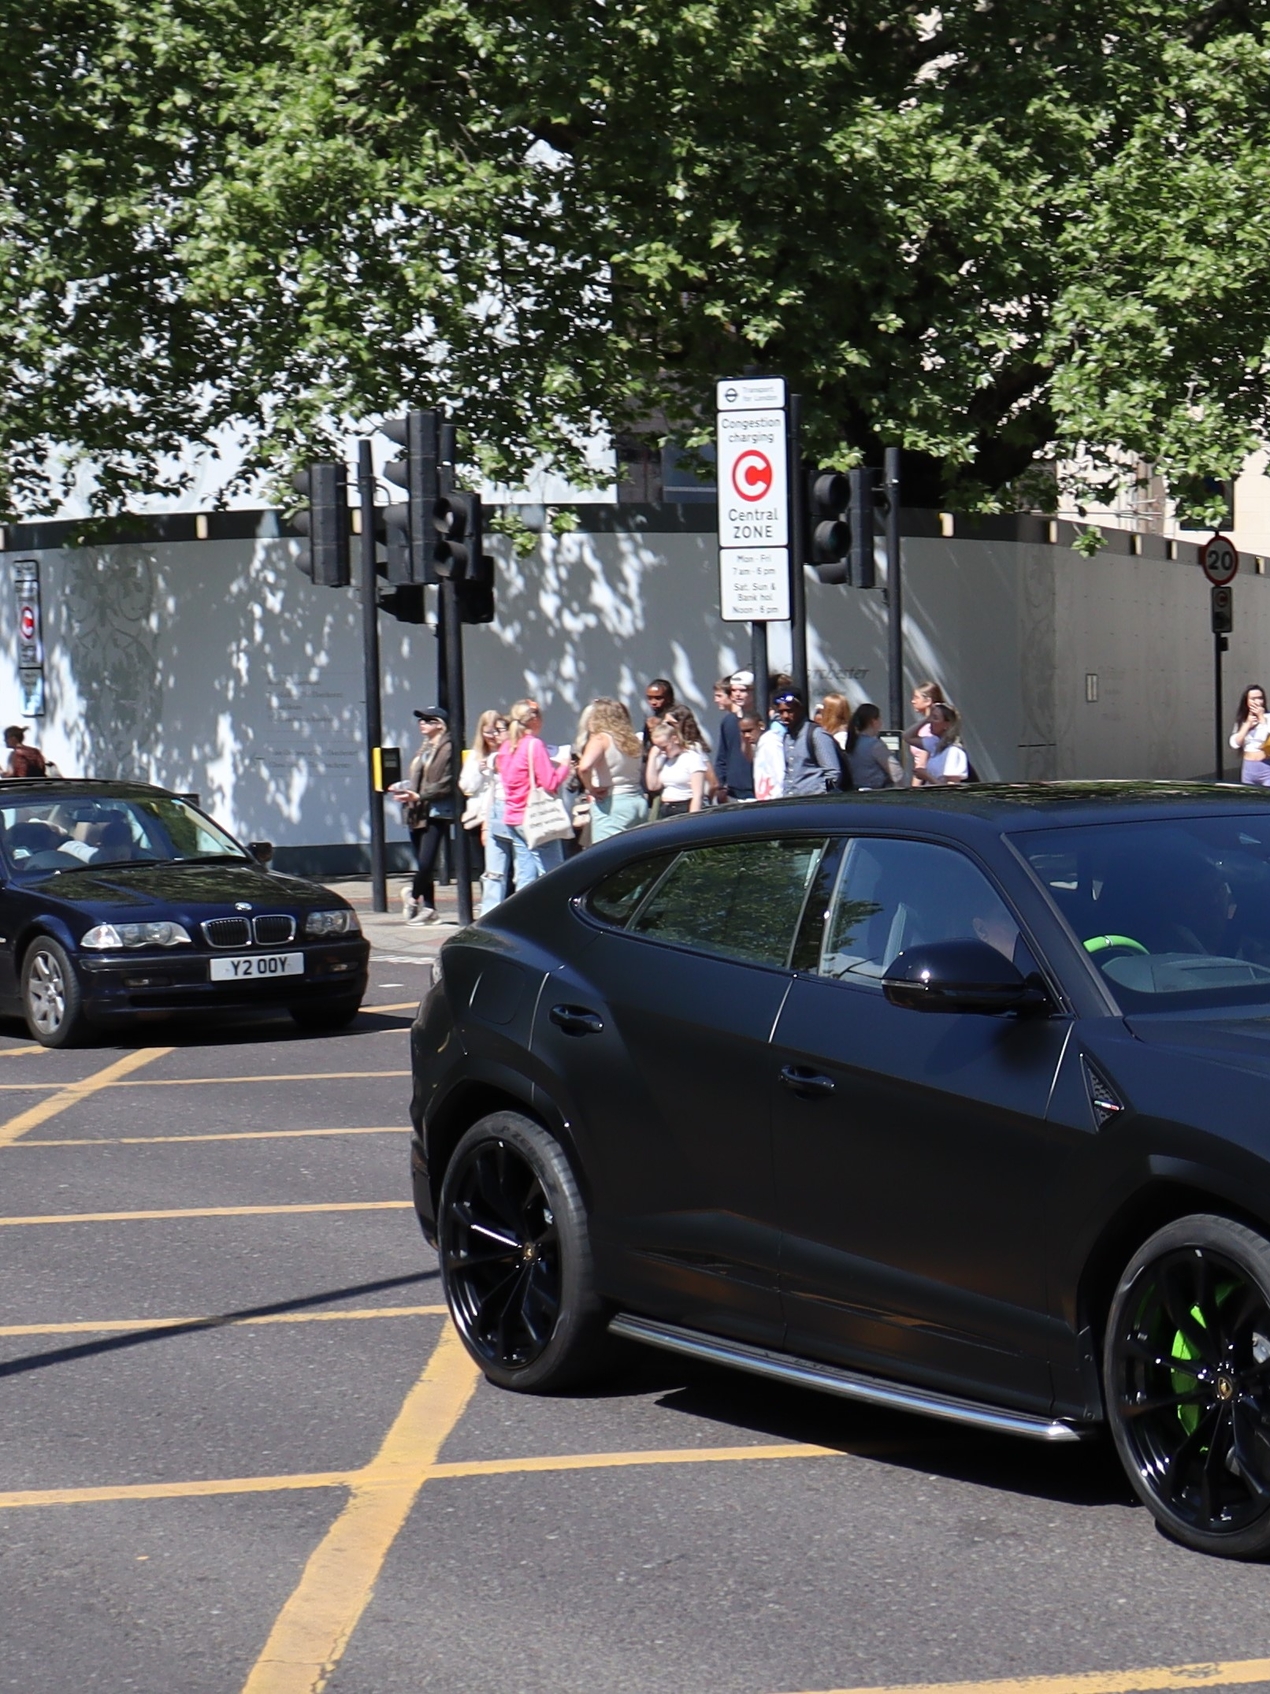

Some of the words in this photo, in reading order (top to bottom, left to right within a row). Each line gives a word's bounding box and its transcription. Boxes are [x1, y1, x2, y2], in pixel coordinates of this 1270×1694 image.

[721, 418, 781, 431] Congestion
[729, 433, 774, 444] charging
[728, 508, 778, 522] Central
[733, 525, 773, 539] ZONE
[760, 554, 771, 562] Fri
[1208, 549, 1233, 571] 20
[752, 583, 768, 591] Sun
[737, 594, 757, 602] Bank
[760, 593, 773, 601] hol
[732, 606, 753, 614] Noon
[231, 959, 253, 977] Y2
